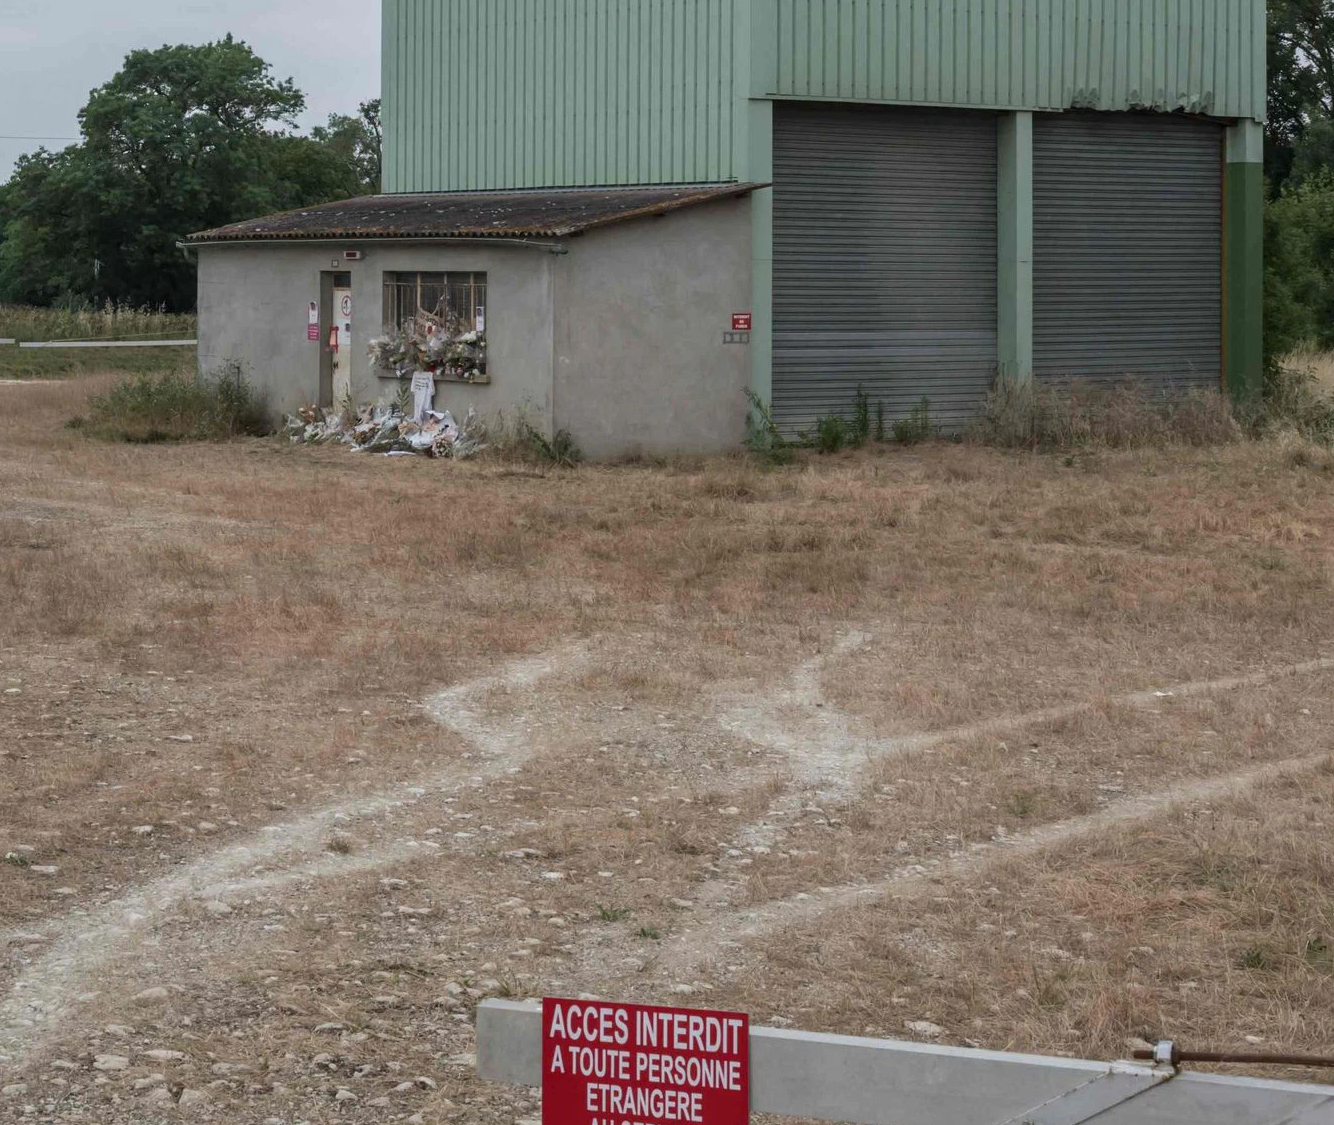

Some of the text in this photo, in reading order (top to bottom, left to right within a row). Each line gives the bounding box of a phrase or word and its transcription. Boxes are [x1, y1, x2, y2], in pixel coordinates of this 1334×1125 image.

[549, 1003, 743, 1055] ACCES INTERDIT
[550, 1045, 741, 1091] A TOUTE PERSONNE
[586, 1082, 703, 1122] ETRANGERE
